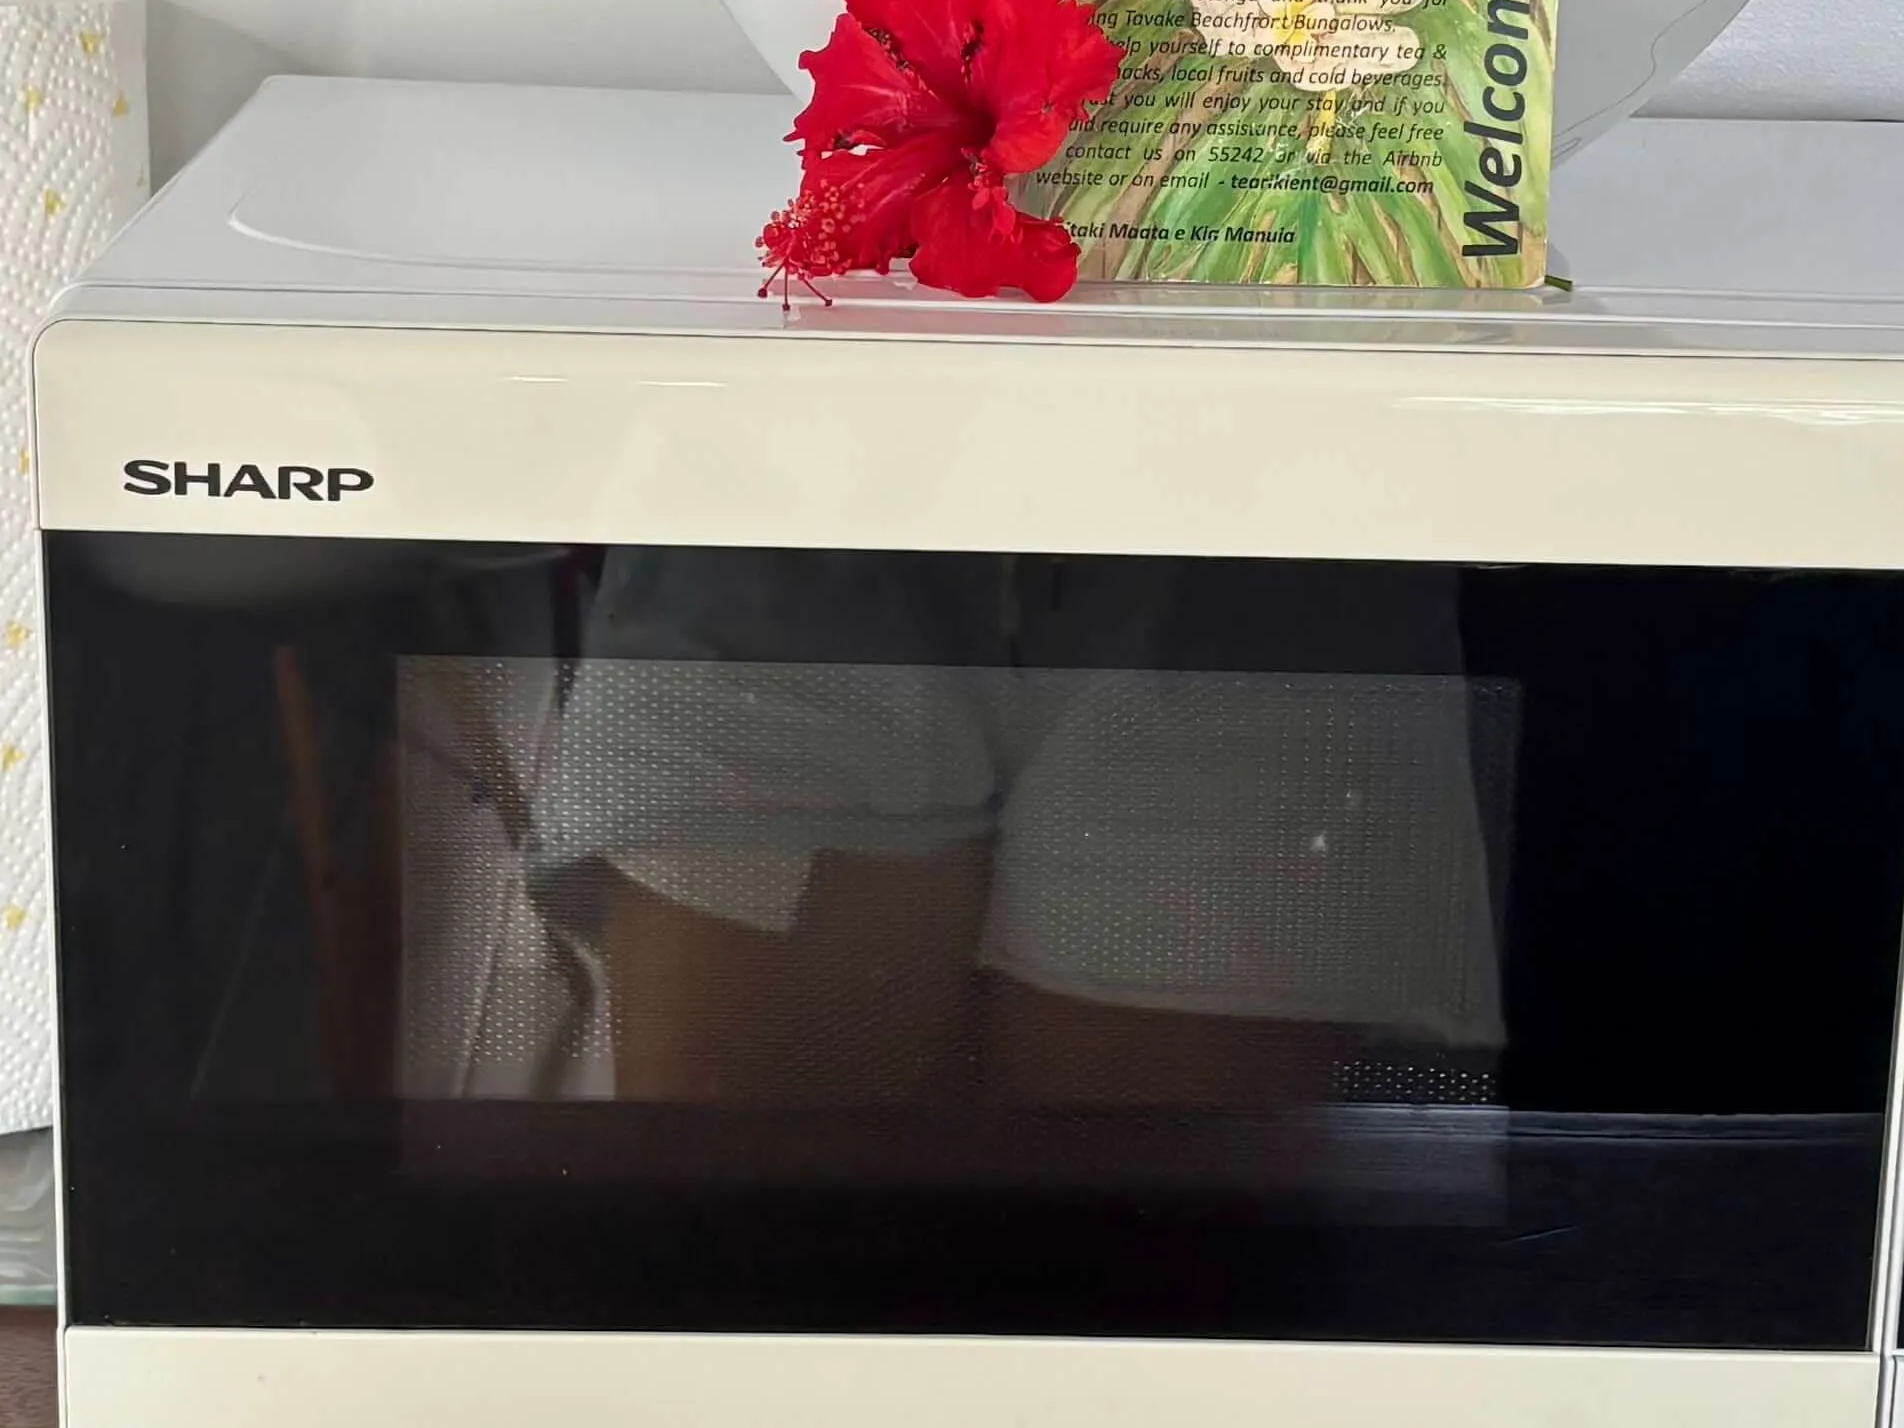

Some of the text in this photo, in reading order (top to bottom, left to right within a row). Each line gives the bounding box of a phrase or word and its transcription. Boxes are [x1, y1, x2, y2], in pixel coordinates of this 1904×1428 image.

[1126, 10, 1185, 27] Tavake
[1149, 39, 1224, 57] yourself
[1229, 41, 1246, 55] to
[1254, 42, 1389, 63] complimentary
[1397, 46, 1425, 60] tea
[1432, 44, 1447, 60] &
[1171, 64, 1212, 81] local
[1216, 65, 1264, 85] fruits
[1269, 69, 1304, 83] and
[1309, 69, 1348, 85] cold
[1123, 94, 1156, 109] you
[1165, 92, 1195, 109] will
[1203, 93, 1251, 114] enjoy
[1259, 97, 1299, 114] your
[1307, 98, 1345, 114] stay
[1351, 96, 1386, 112] and
[1393, 98, 1405, 115] if
[1413, 101, 1445, 115] you
[1101, 120, 1163, 138] require
[1169, 121, 1200, 138] any
[1206, 120, 1301, 140] assistance,
[1307, 123, 1365, 144] please
[1369, 123, 1404, 142] feel
[1406, 124, 1444, 143] free
[1066, 145, 1132, 160] contact
[1143, 147, 1162, 161] us
[1174, 147, 1196, 162] on
[1208, 146, 1264, 163] 55242
[1306, 150, 1331, 164] via
[1343, 150, 1372, 165] the
[1383, 150, 1442, 167] Airbnb
[1036, 170, 1104, 186] website
[1109, 174, 1126, 186] or
[1132, 174, 1154, 187] on
[1160, 172, 1209, 189] email
[1109, 223, 1169, 240] Maata
[1175, 227, 1185, 240] e
[1224, 226, 1296, 243] Manuia
[124, 460, 374, 501] SHARP
